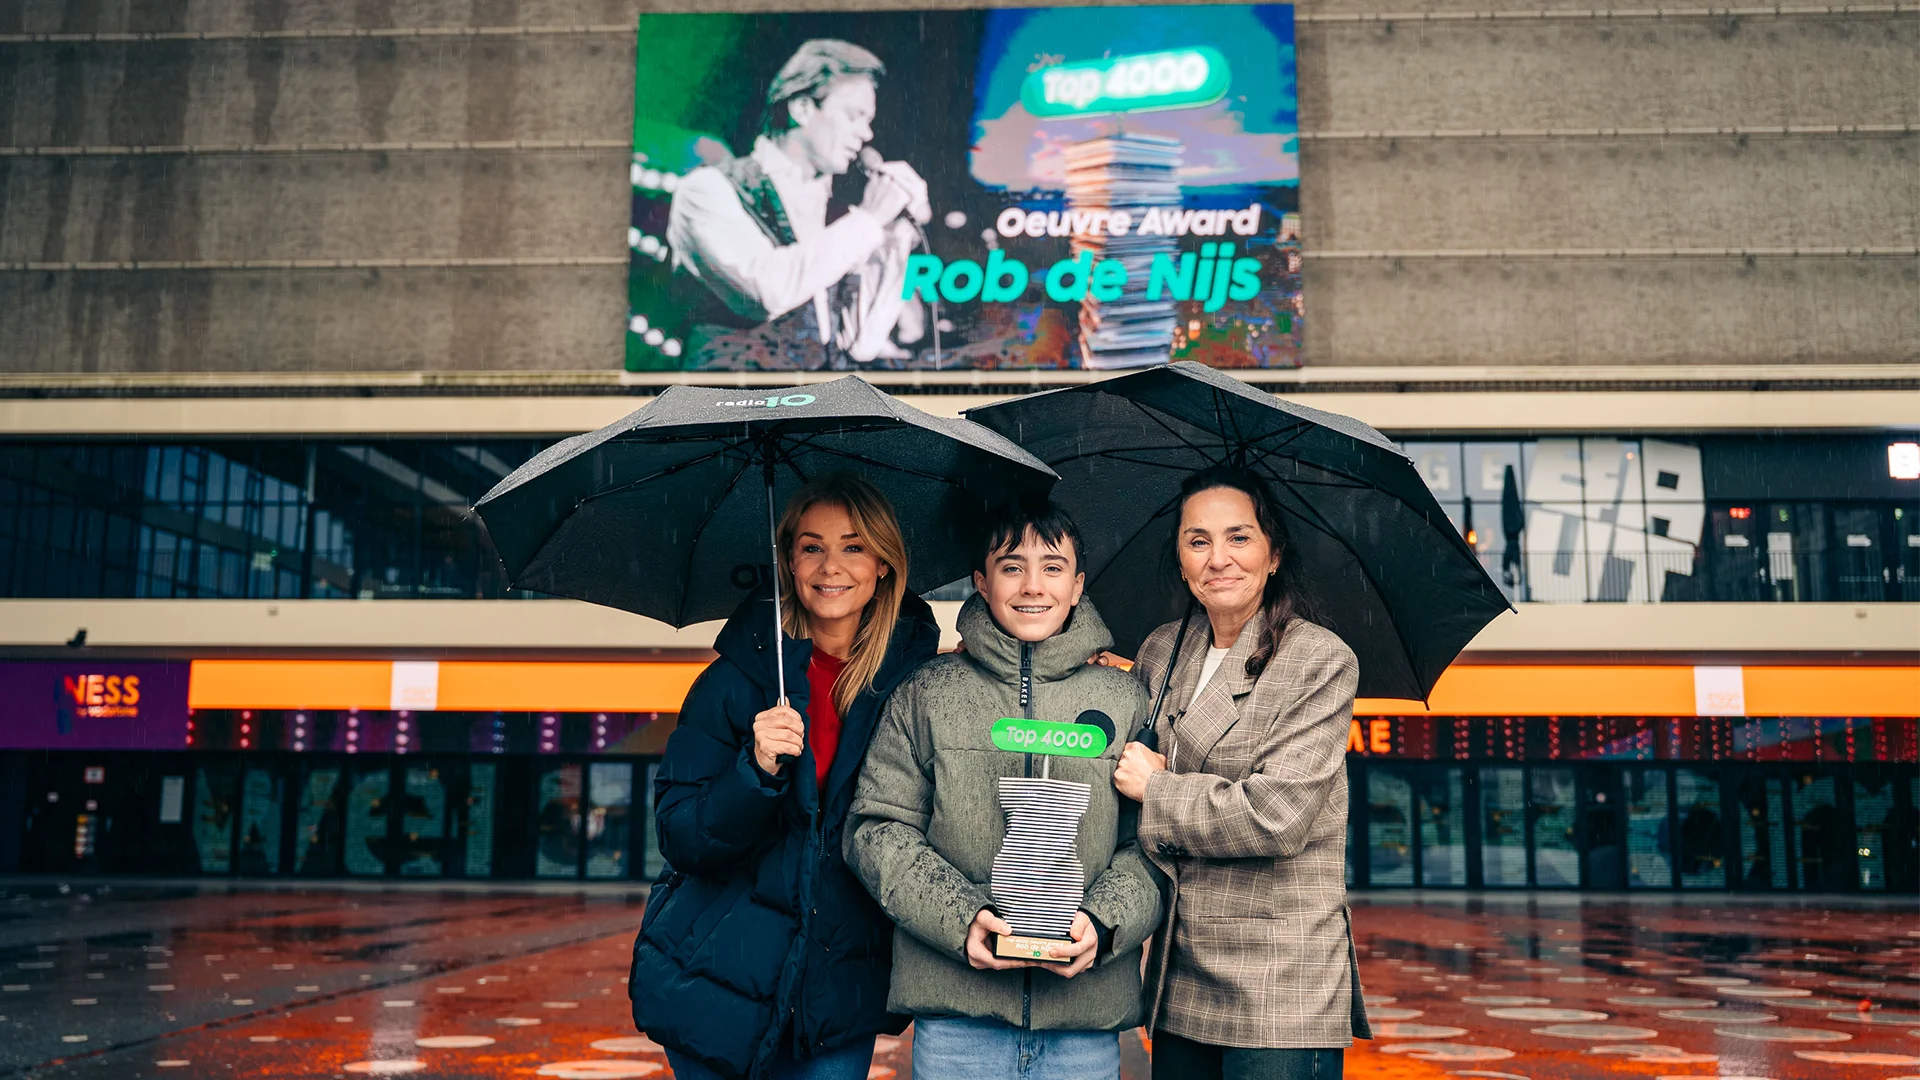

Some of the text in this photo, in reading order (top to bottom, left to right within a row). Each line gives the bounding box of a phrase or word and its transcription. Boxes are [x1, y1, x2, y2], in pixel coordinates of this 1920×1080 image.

[1042, 51, 1210, 110] Top 4000
[996, 203, 1262, 238] Oeuvre Award
[901, 242, 1263, 313] Rob de Nijs
[1020, 676, 1029, 704] BAKER
[1006, 726, 1093, 749] Top 4000
